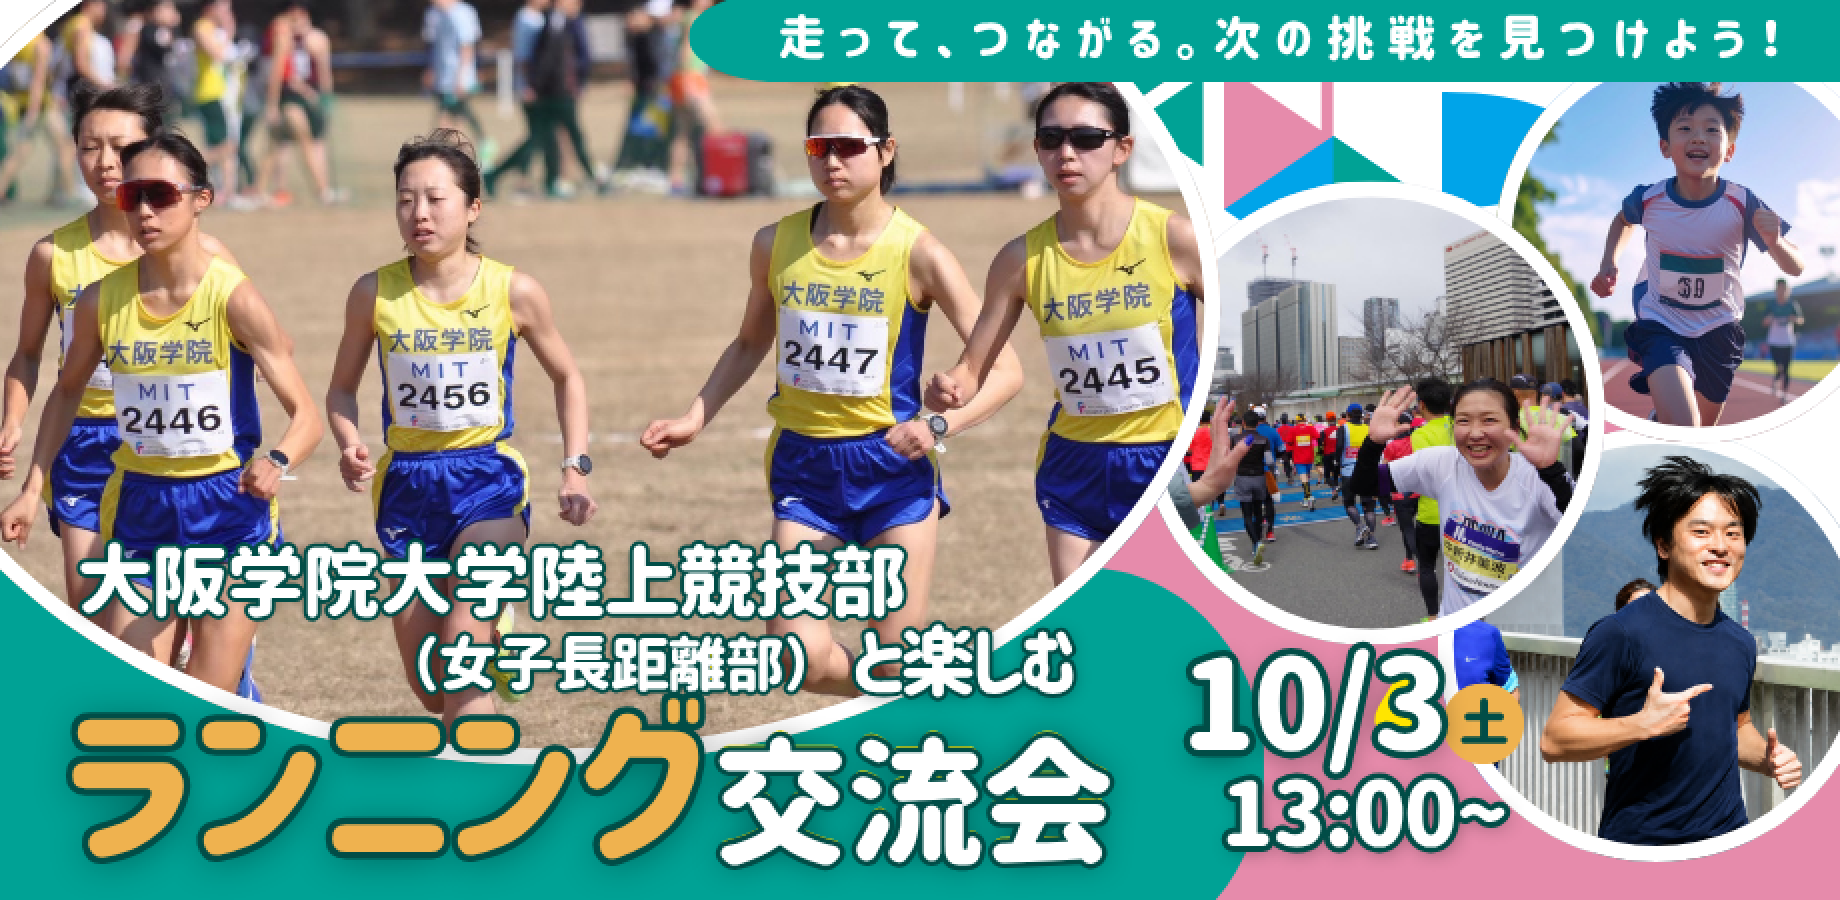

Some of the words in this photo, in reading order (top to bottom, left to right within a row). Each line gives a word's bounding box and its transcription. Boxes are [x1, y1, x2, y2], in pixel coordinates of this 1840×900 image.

[782, 280, 885, 313] 大阪学院
[1044, 281, 1152, 324] 大阪学院
[389, 326, 493, 352] 大阪学院
[799, 319, 858, 340] MIT
[108, 338, 214, 365] 大阪学院
[784, 340, 878, 374] 2447
[1068, 337, 1129, 361] MIT
[411, 361, 469, 378] MIT
[1059, 356, 1161, 394] 2445
[138, 382, 195, 400] MIT
[397, 382, 490, 410] 2456
[121, 405, 222, 434] 2446
